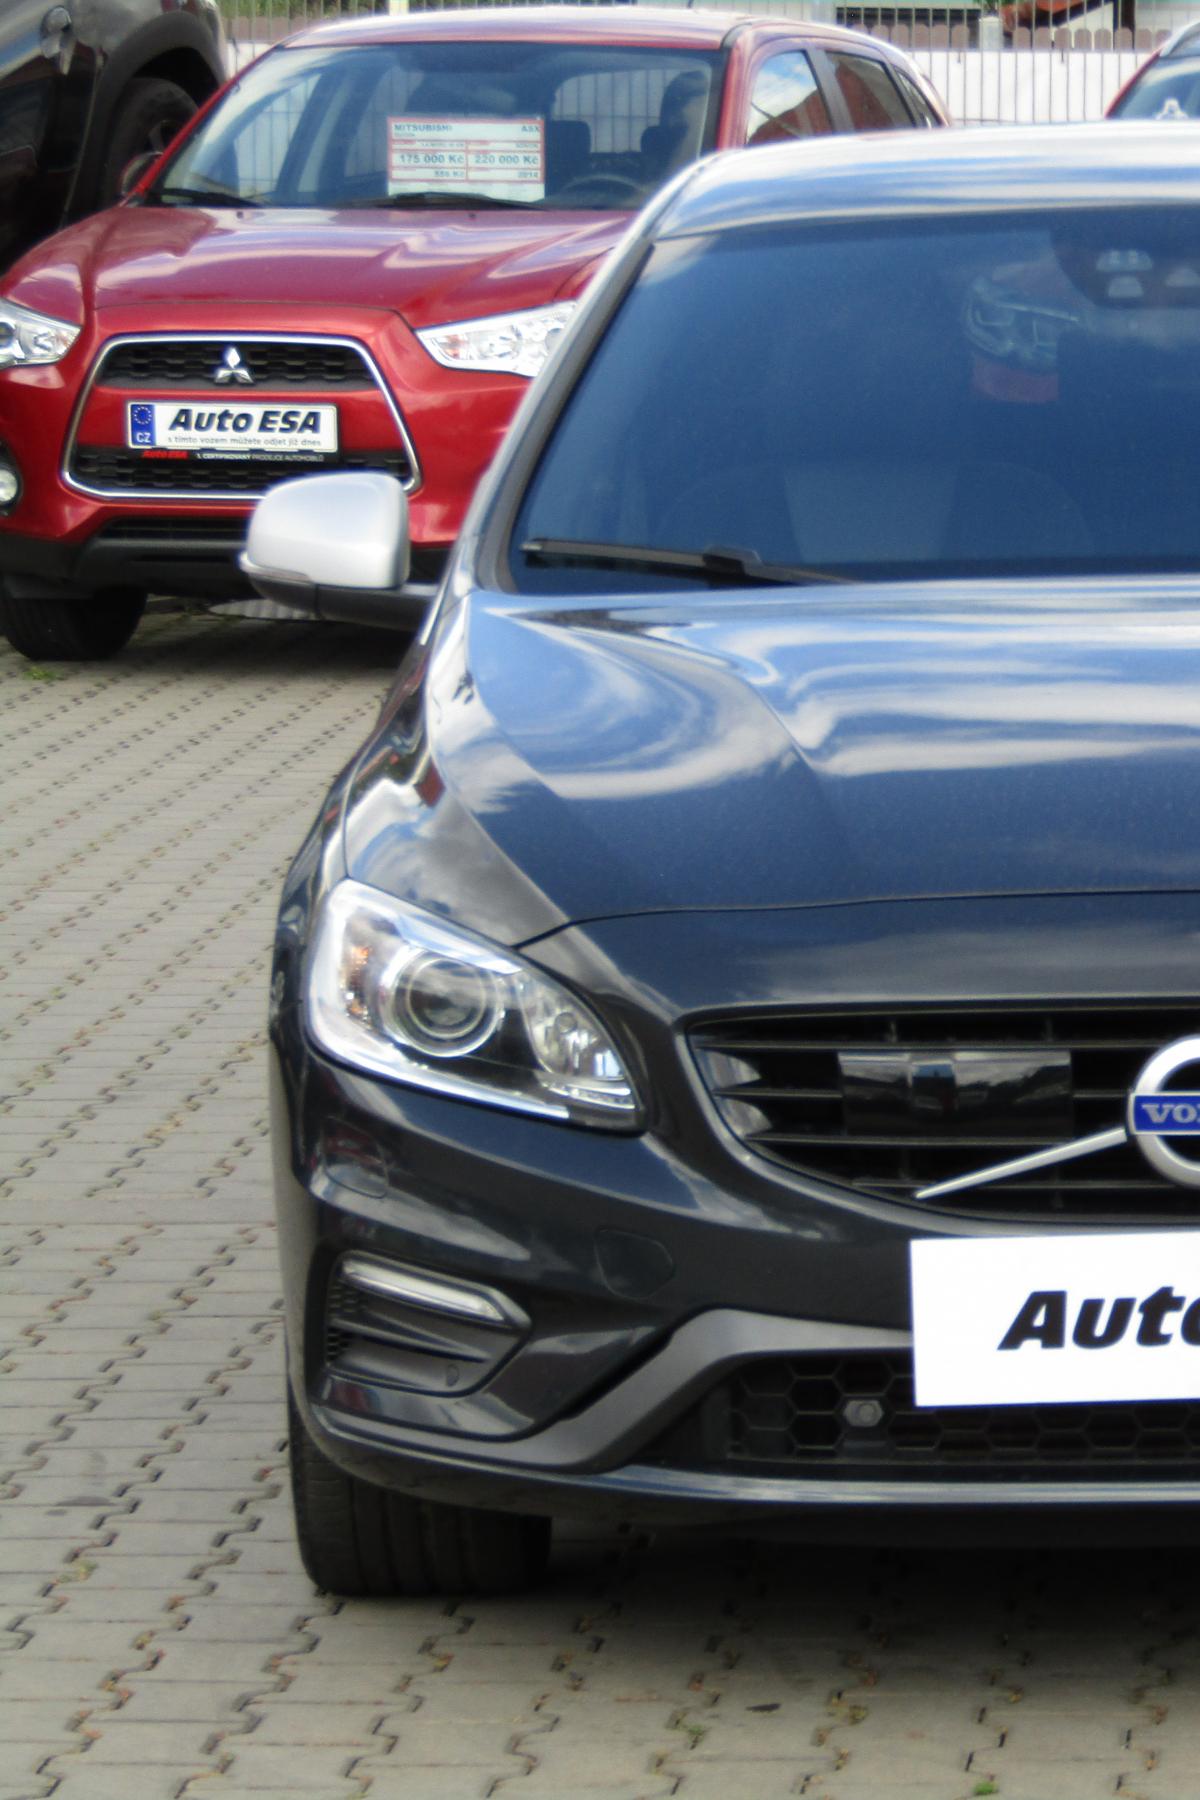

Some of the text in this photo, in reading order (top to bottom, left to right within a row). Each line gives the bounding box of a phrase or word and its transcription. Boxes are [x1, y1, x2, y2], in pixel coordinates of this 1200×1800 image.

[400, 153, 465, 163] 175 000 Kč
[475, 154, 538, 164] 220 000 Kč
[168, 408, 321, 434] Auto ESA
[136, 432, 151, 443] CZ
[263, 436, 287, 447] odjet
[300, 437, 322, 447] dnes
